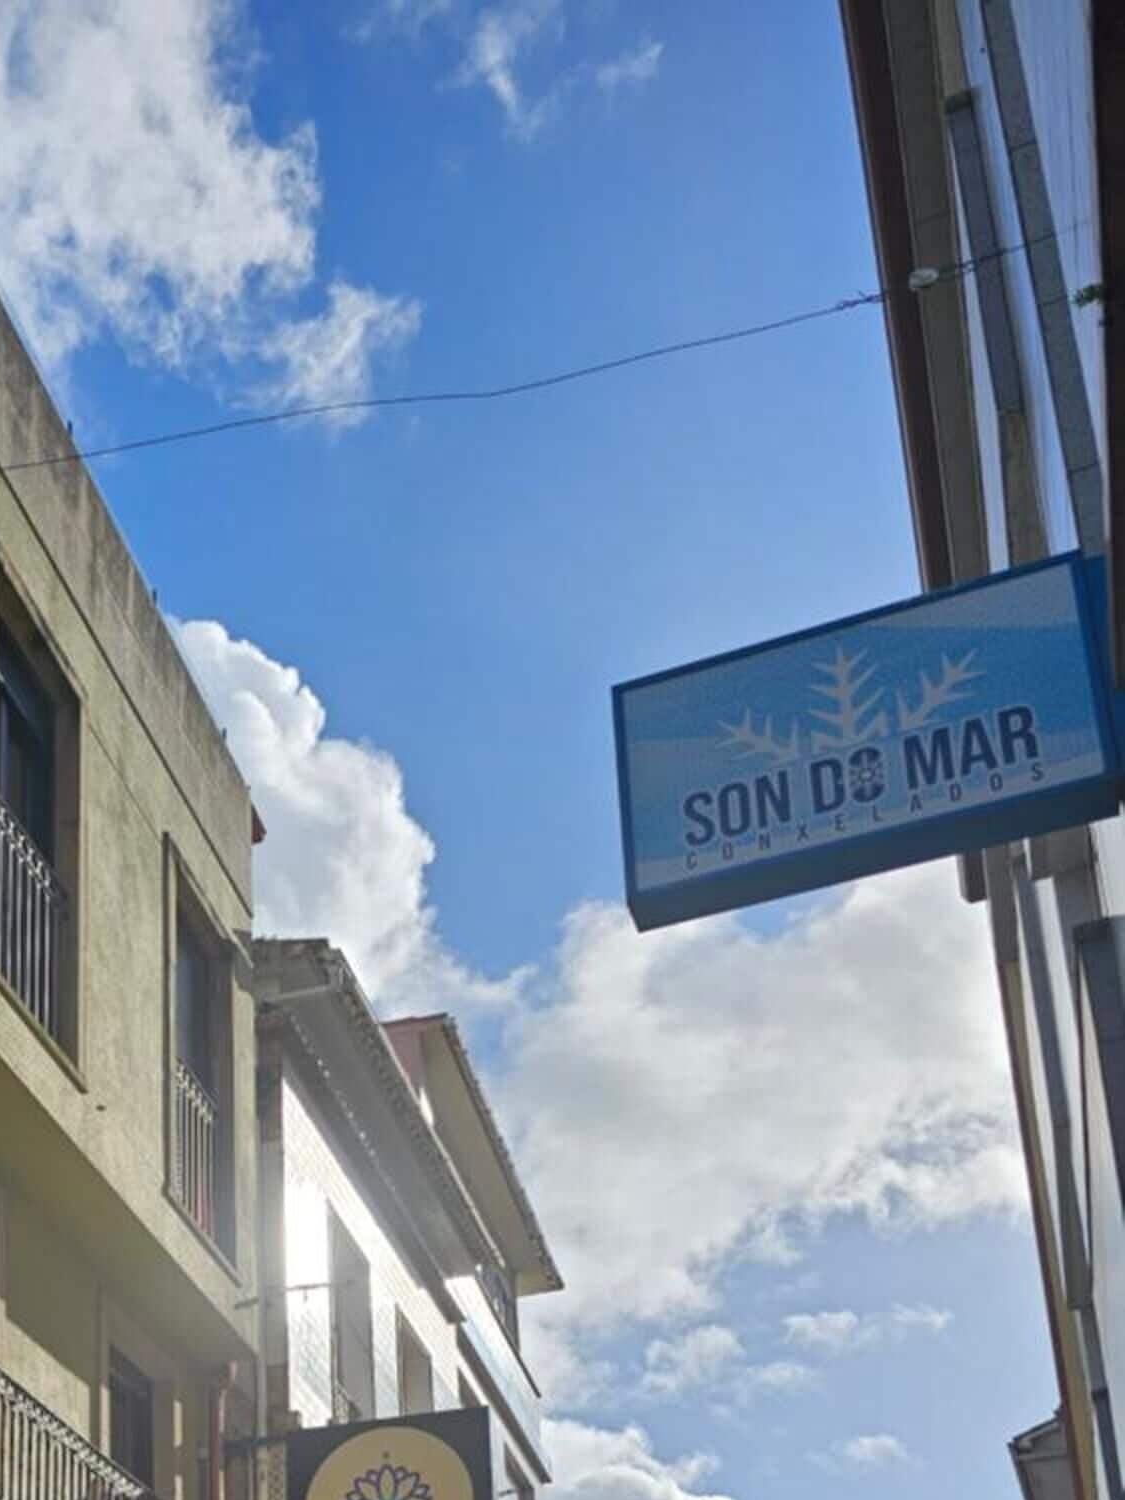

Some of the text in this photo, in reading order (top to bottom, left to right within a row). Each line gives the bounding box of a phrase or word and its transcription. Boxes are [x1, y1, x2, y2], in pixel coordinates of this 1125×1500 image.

[682, 704, 1040, 847] SON DO MAR
[686, 764, 1046, 871] CONXELADOS
